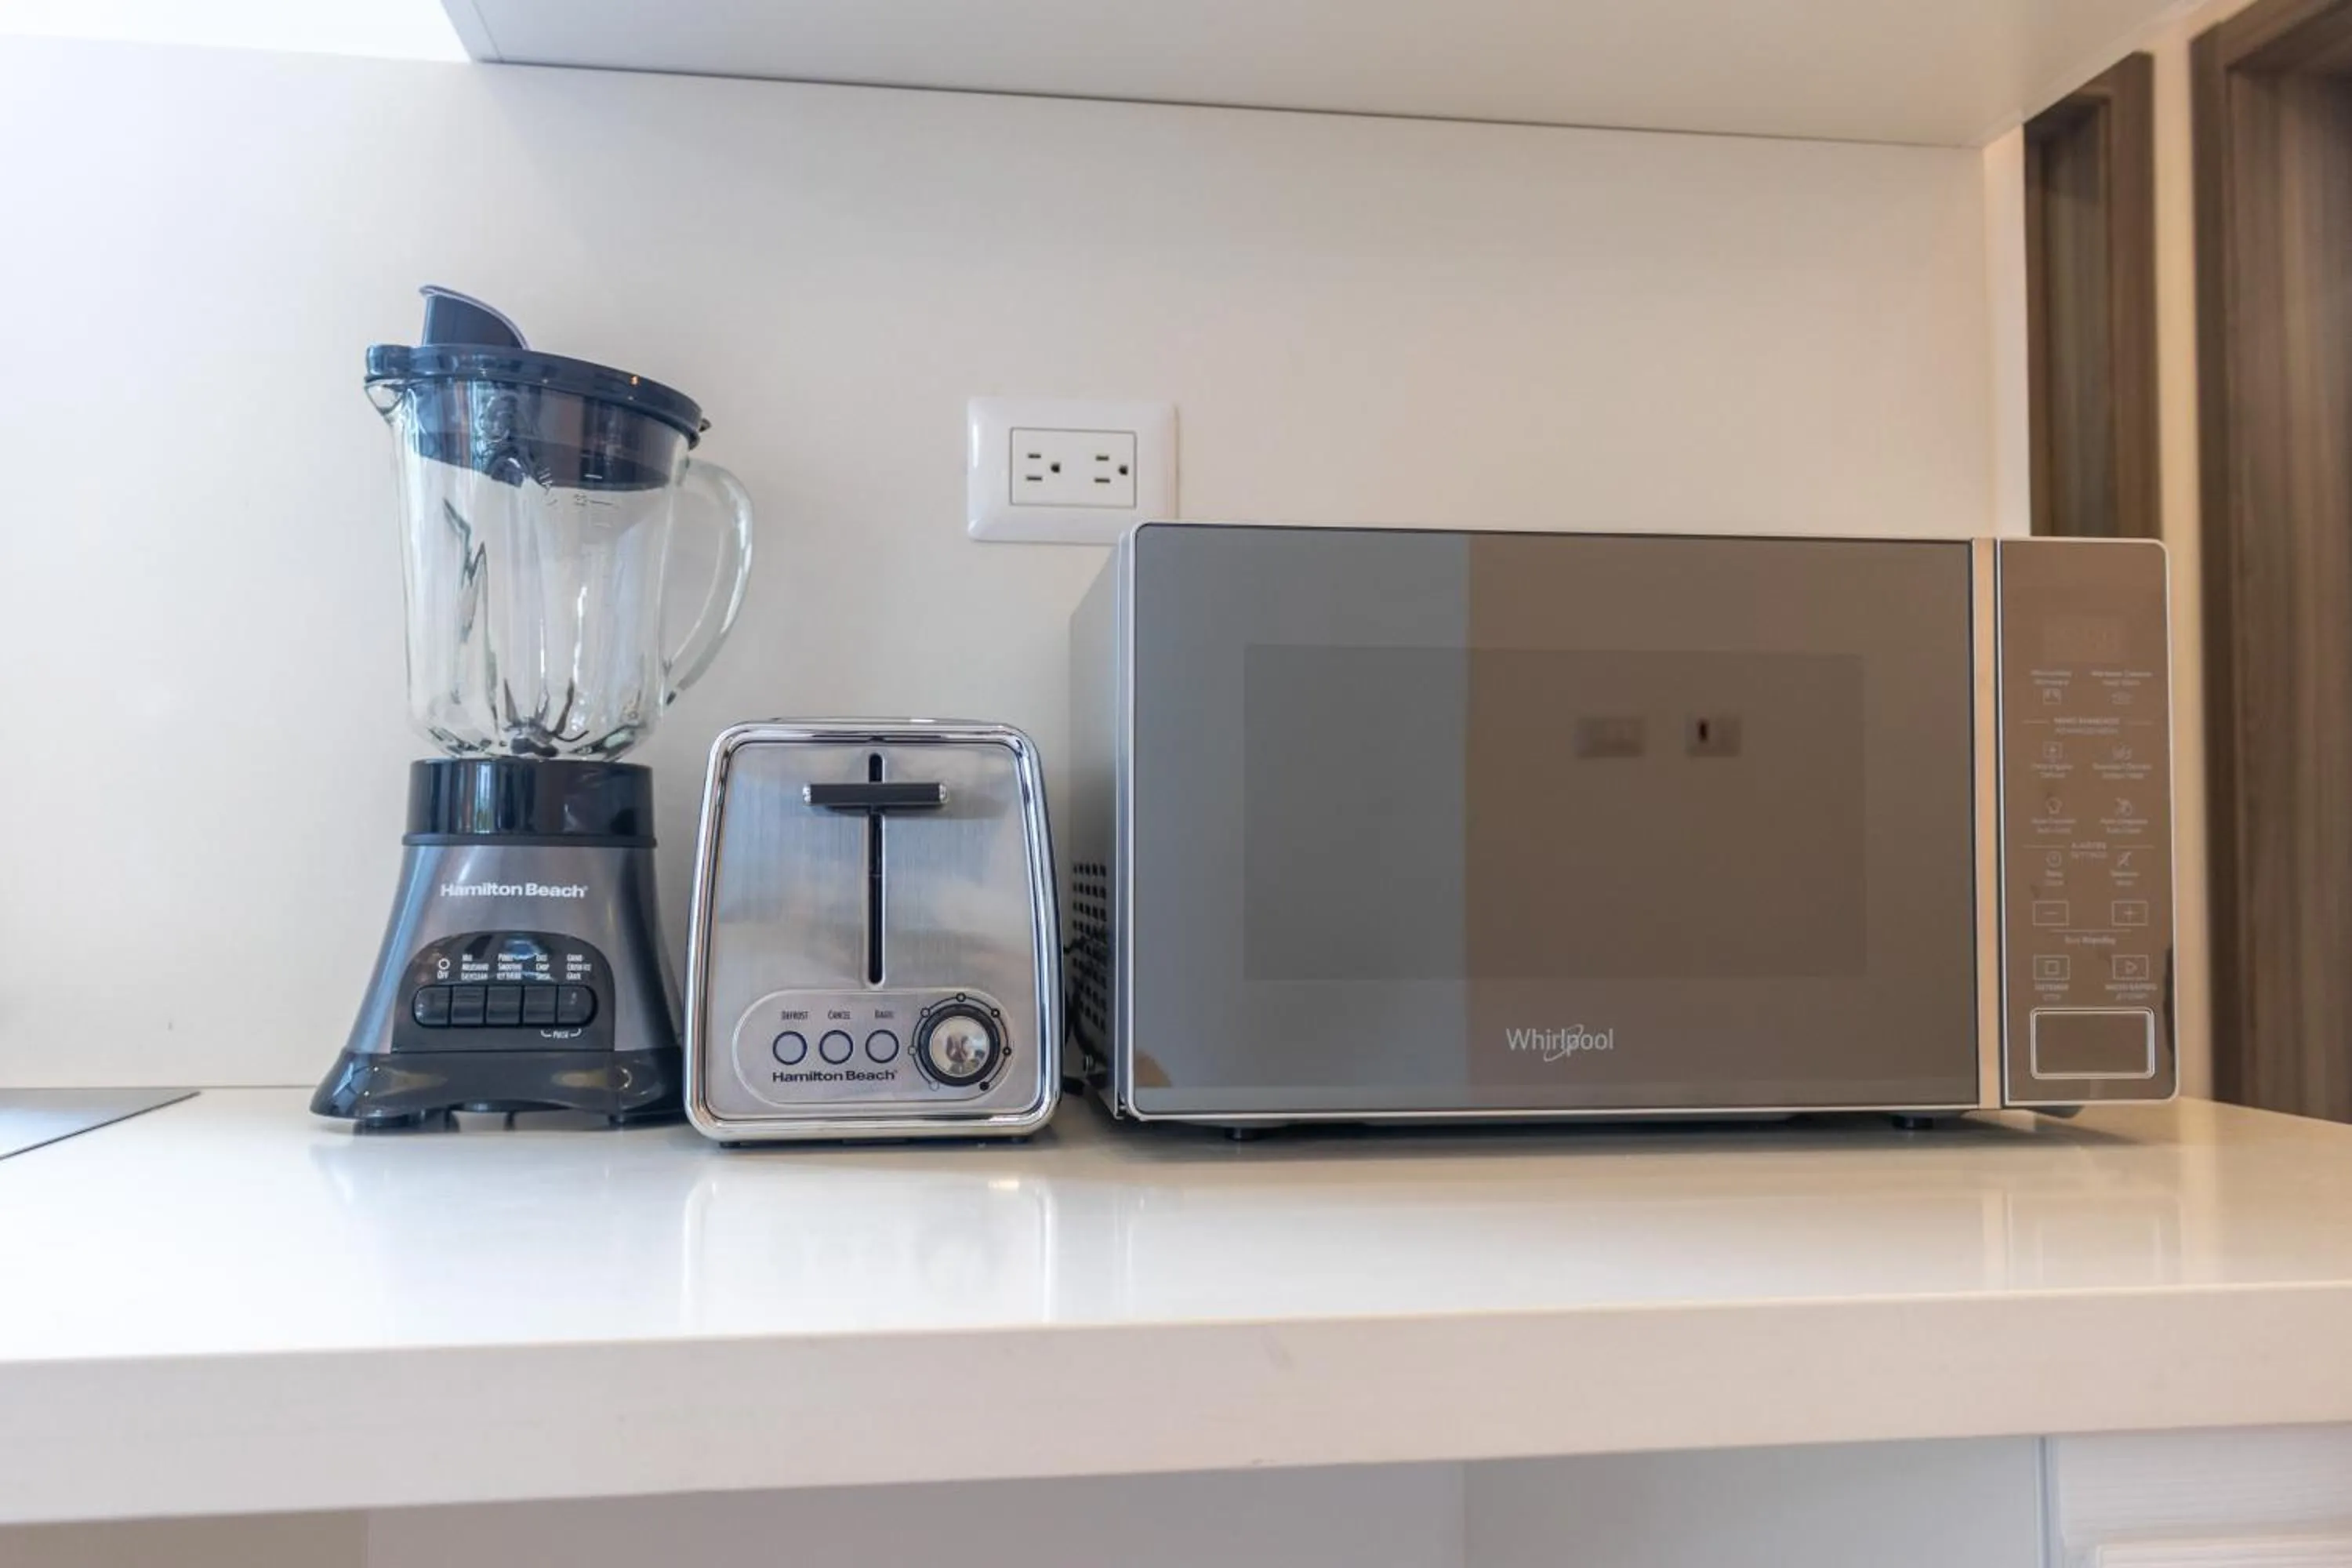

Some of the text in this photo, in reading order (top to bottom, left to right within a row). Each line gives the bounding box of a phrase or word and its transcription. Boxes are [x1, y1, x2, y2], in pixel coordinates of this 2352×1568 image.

[439, 882, 586, 898] Hamilton Beach
[1505, 1026, 1614, 1058] Whirlpool
[772, 1069, 896, 1083] Hamilton Beach
